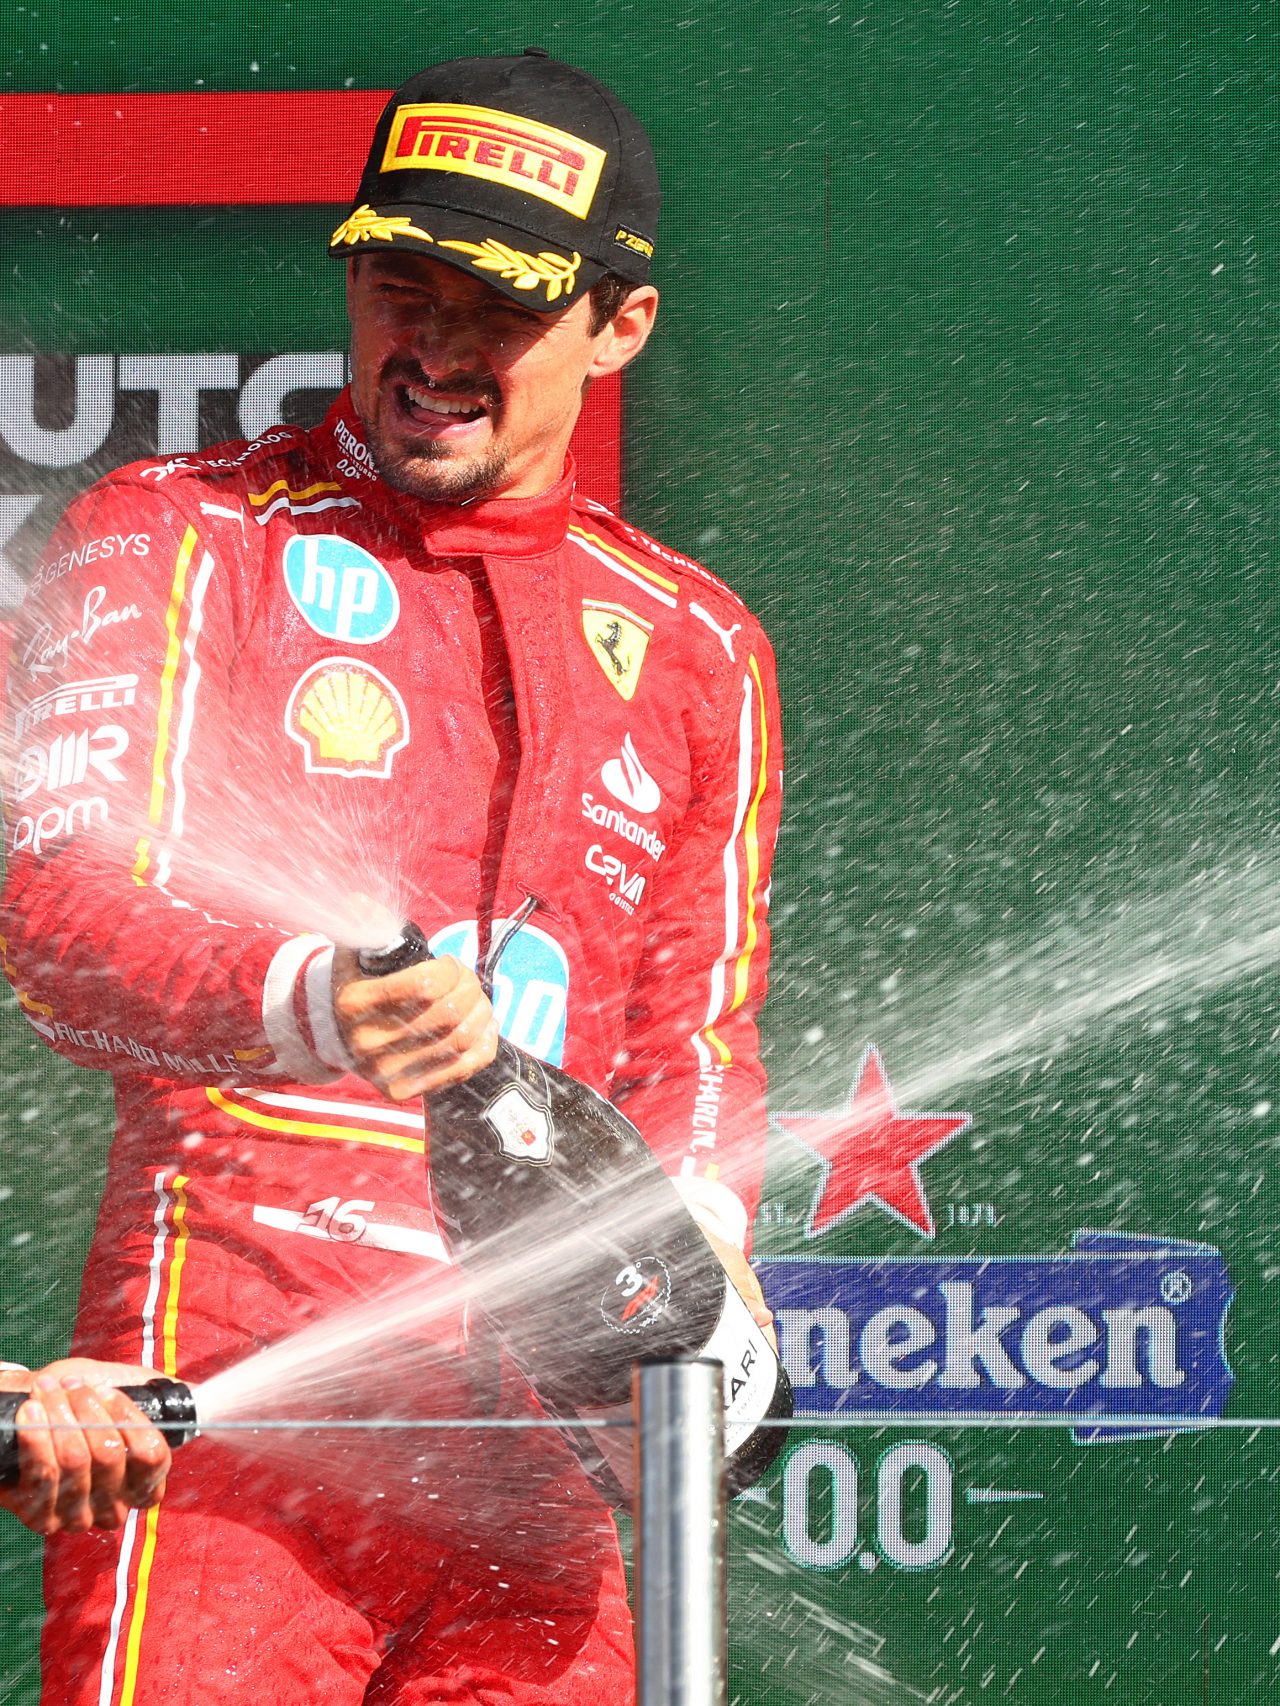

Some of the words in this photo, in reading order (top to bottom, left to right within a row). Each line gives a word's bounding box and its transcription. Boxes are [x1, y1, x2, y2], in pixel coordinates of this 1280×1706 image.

[396, 115, 586, 197] PIRELLI
[45, 533, 151, 588] GENESYS
[300, 537, 380, 640] hp
[22, 585, 142, 682] Ray-Ban
[581, 792, 667, 862] Santander
[53, 1021, 161, 1067] RICHARD
[297, 1196, 375, 1242] 16
[782, 1439, 956, 1571] 0.0
